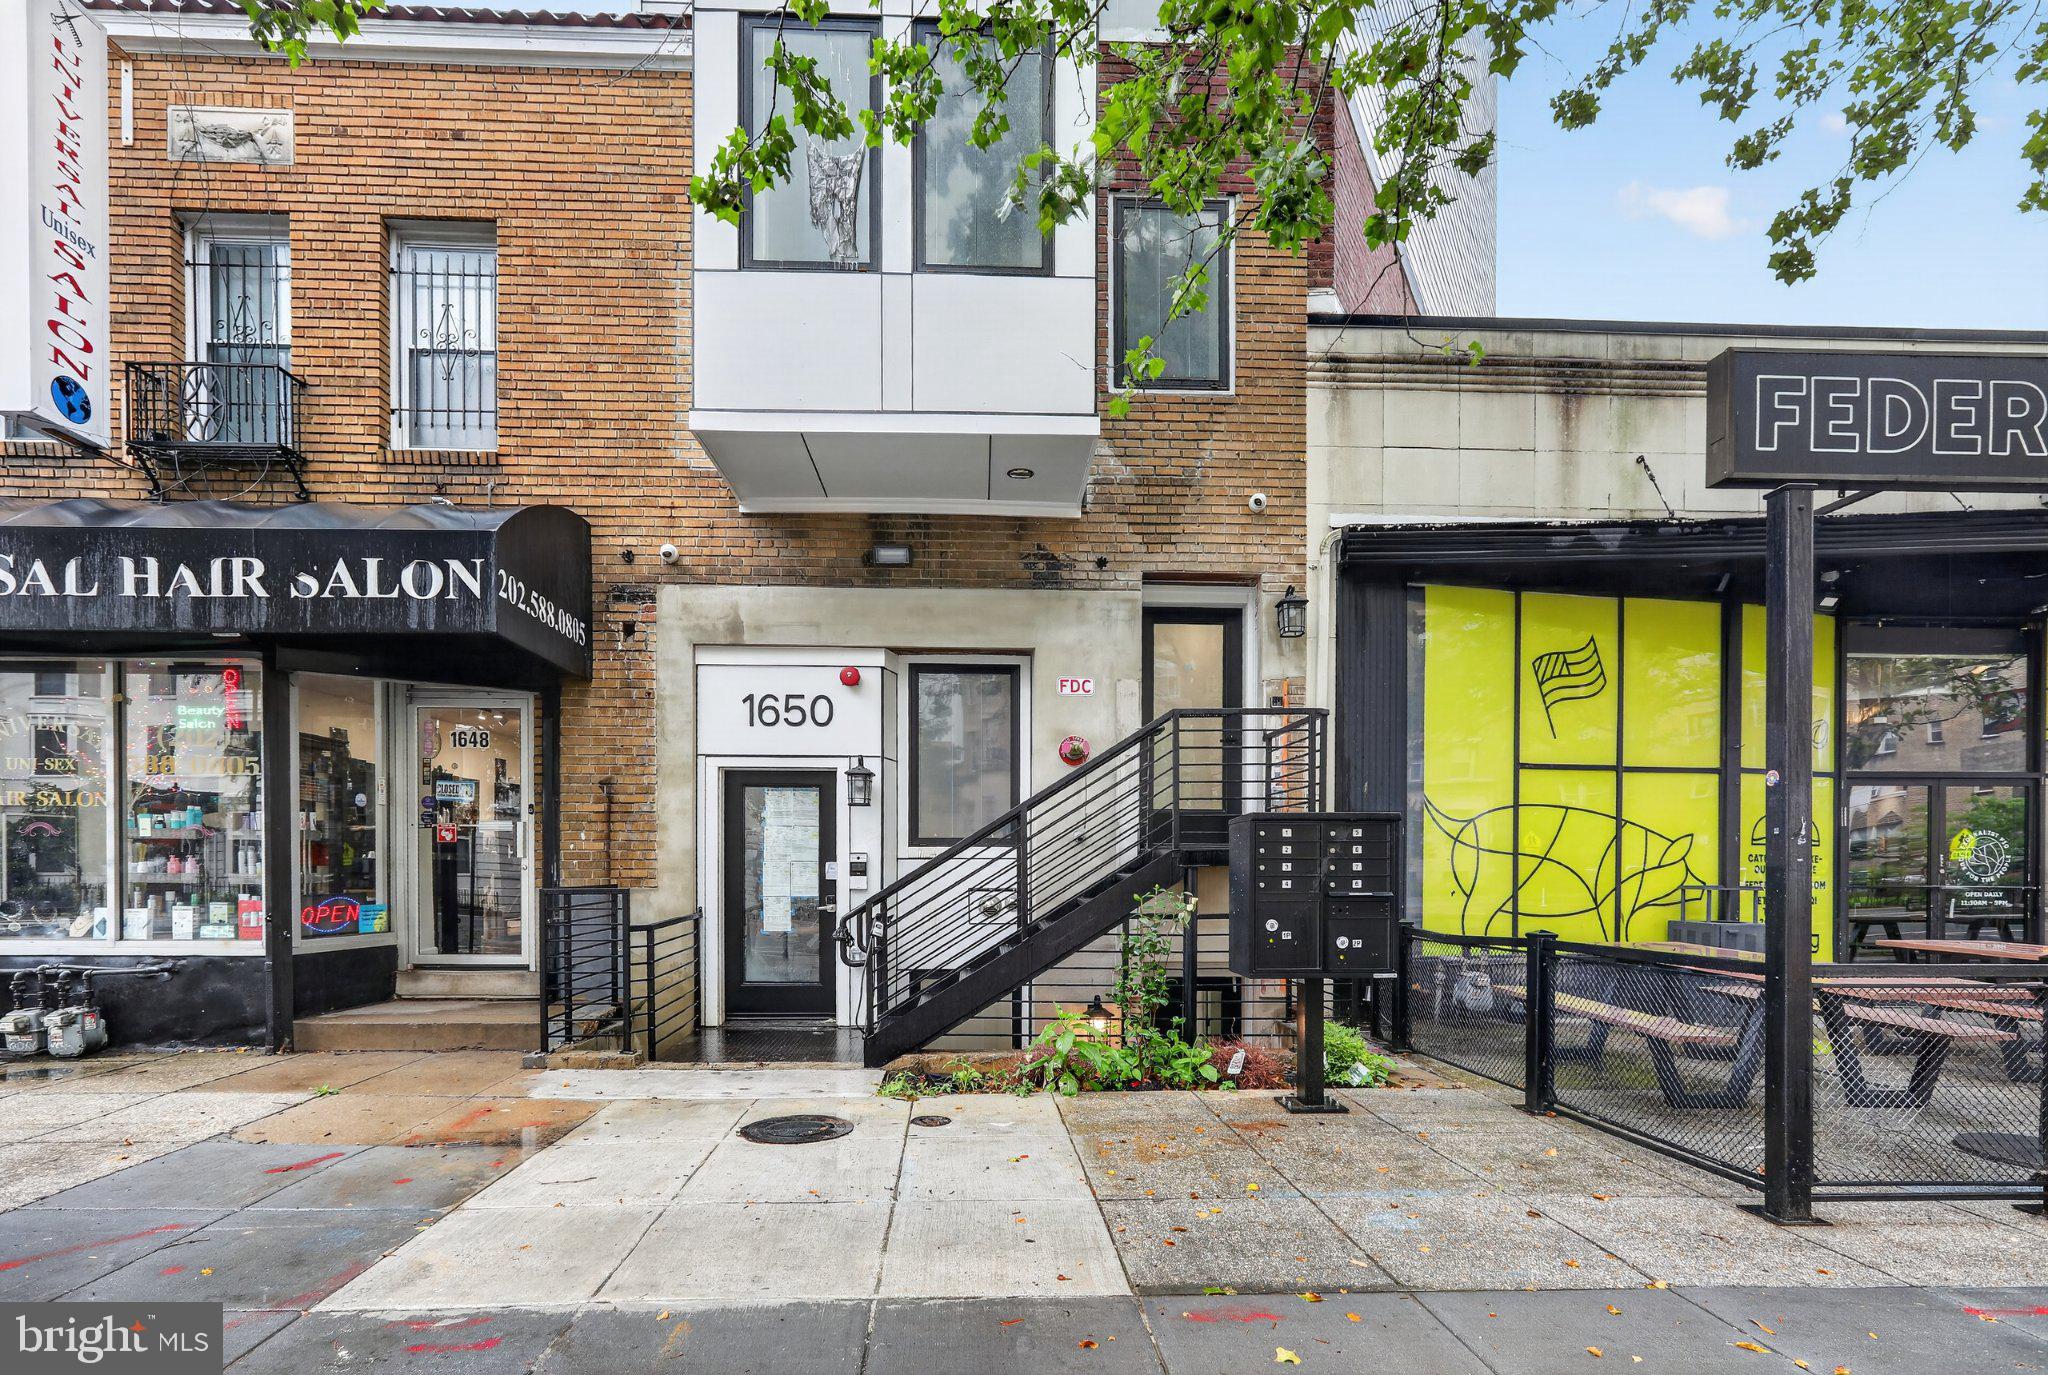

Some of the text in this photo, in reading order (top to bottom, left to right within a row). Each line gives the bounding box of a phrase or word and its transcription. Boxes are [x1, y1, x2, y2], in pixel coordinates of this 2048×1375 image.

[51, 34, 86, 226] UNIVERSAL
[40, 204, 96, 259] Unisex
[47, 239, 94, 382] SALON
[1755, 374, 2048, 456] FEDER
[118, 556, 270, 598] HAIR
[290, 557, 485, 600] SALON
[498, 568, 586, 646] 202.588.0805
[1059, 679, 1092, 693] FDC
[177, 705, 226, 718] Beauty
[741, 693, 834, 727] 1650
[178, 719, 217, 729] Salon
[450, 731, 490, 748] 1648
[36, 790, 107, 807] SALON
[437, 783, 459, 794] CLOSED
[301, 905, 360, 925] OPEN
